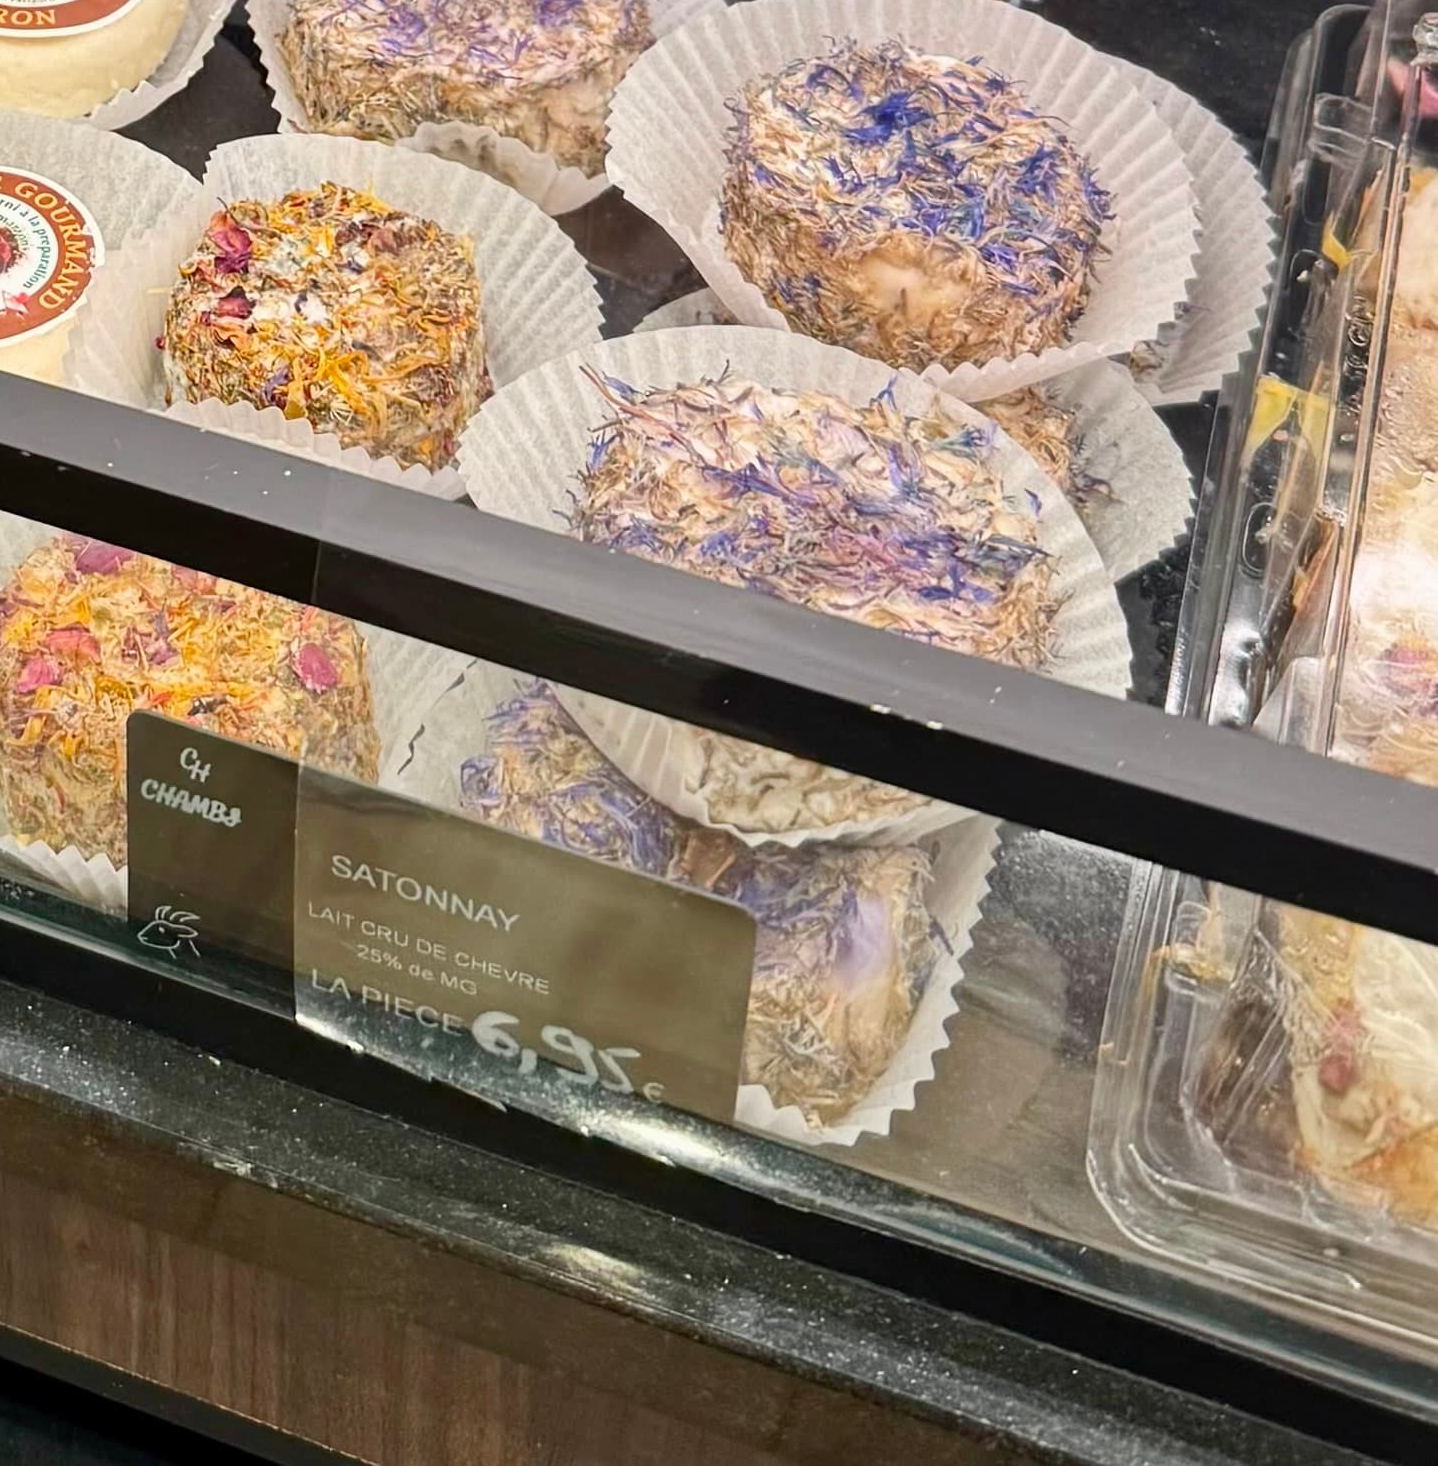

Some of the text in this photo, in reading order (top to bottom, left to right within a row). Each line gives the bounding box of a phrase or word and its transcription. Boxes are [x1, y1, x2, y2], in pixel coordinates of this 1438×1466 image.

[14, 182, 87, 309] GOURMAND
[331, 855, 520, 932] SATONNAY
[309, 901, 550, 995] LAIT CRU DE CHEVRE
[357, 944, 478, 996] 25% de MG
[312, 969, 351, 1000] LA
[363, 985, 463, 1036] PIECE
[472, 1011, 642, 1095] 6,95
